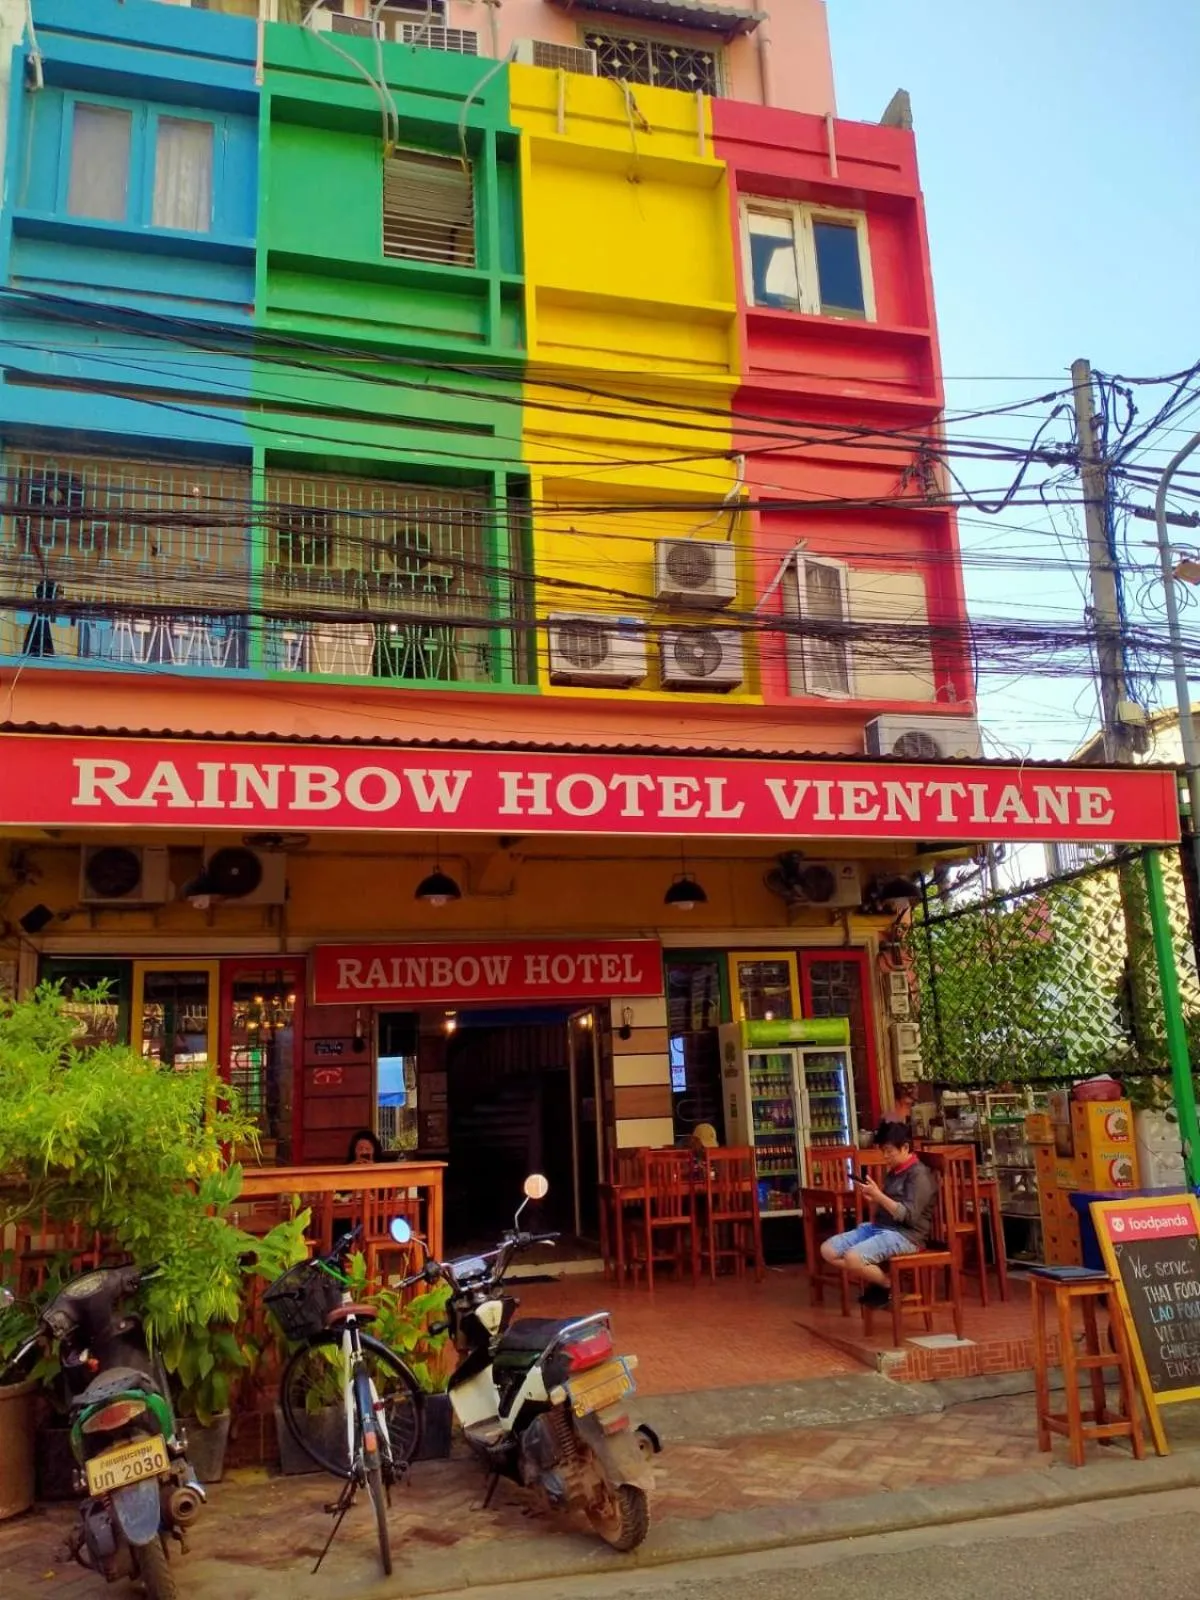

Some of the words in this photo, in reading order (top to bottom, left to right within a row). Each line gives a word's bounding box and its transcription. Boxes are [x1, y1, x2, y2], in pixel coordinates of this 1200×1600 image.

[71, 758, 472, 813] RAINBOW
[498, 771, 745, 818] HOTEL
[764, 778, 1114, 825] VIENTIANE
[336, 955, 512, 989] RAINBOW
[523, 954, 643, 985] HOTEL
[1128, 1215, 1188, 1231] foodpanda
[1128, 1256, 1151, 1279] We
[1143, 1284, 1172, 1303] THAI
[1149, 1305, 1174, 1324] LAO
[122, 1453, 163, 1480] 2030
